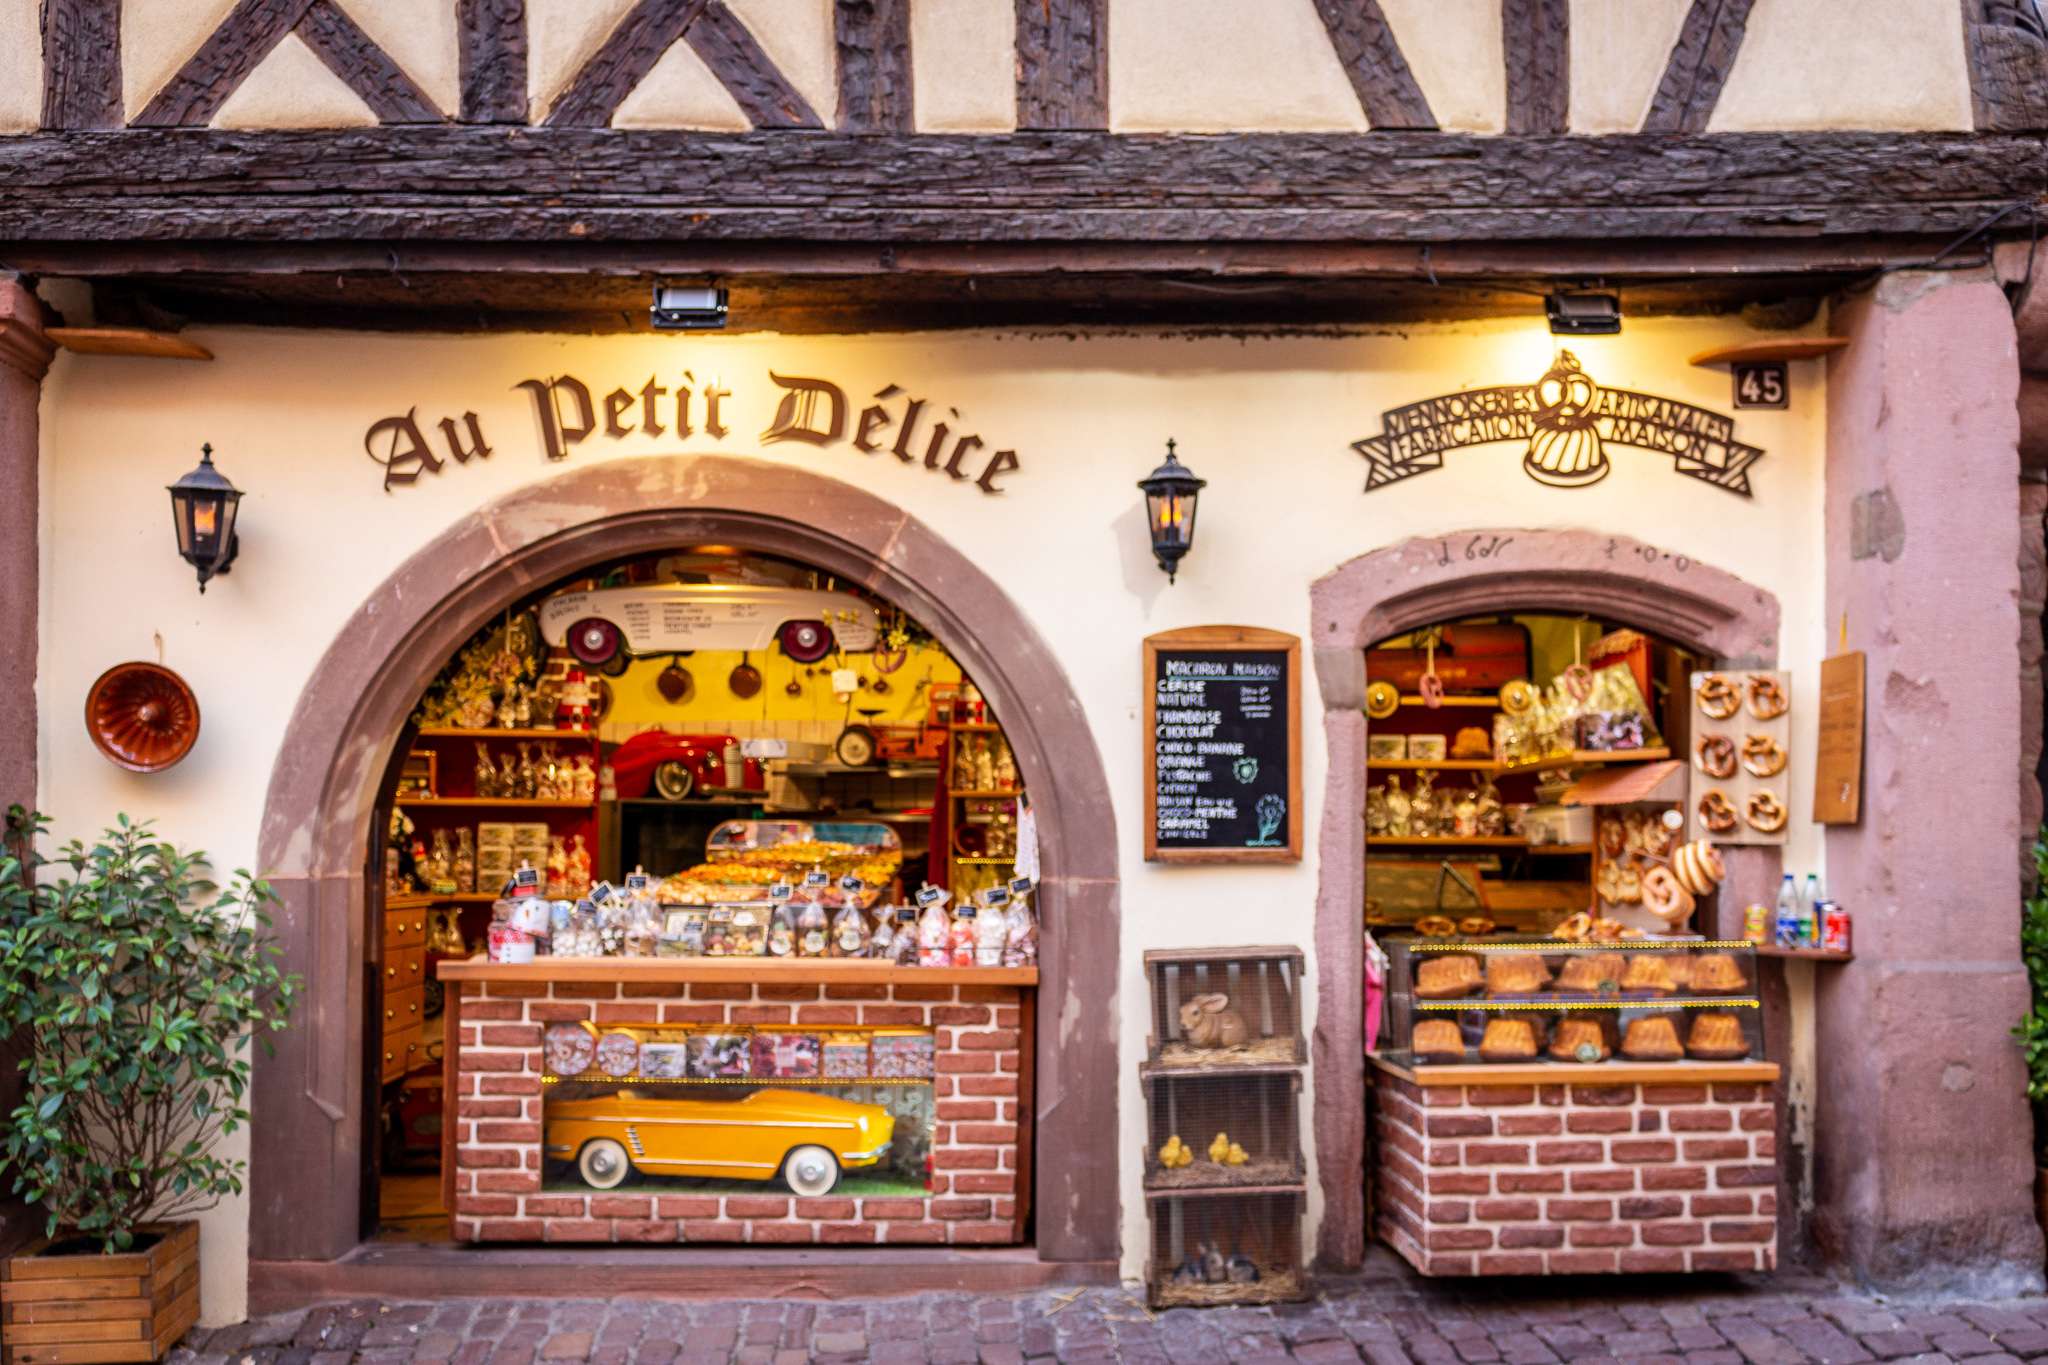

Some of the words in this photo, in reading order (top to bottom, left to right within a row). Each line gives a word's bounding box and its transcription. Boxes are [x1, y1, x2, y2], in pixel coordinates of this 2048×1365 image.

[1740, 369, 1783, 403] 45
[364, 405, 493, 494] Au
[512, 369, 732, 461] Petit
[759, 368, 1021, 496] Délice
[1387, 388, 1540, 437] VIENNOISERIES
[1591, 390, 1731, 444] ARTISANALES
[1391, 414, 1536, 464] FABRICATION
[1611, 418, 1708, 462] MAISON
[1157, 693, 1207, 707] NATURE
